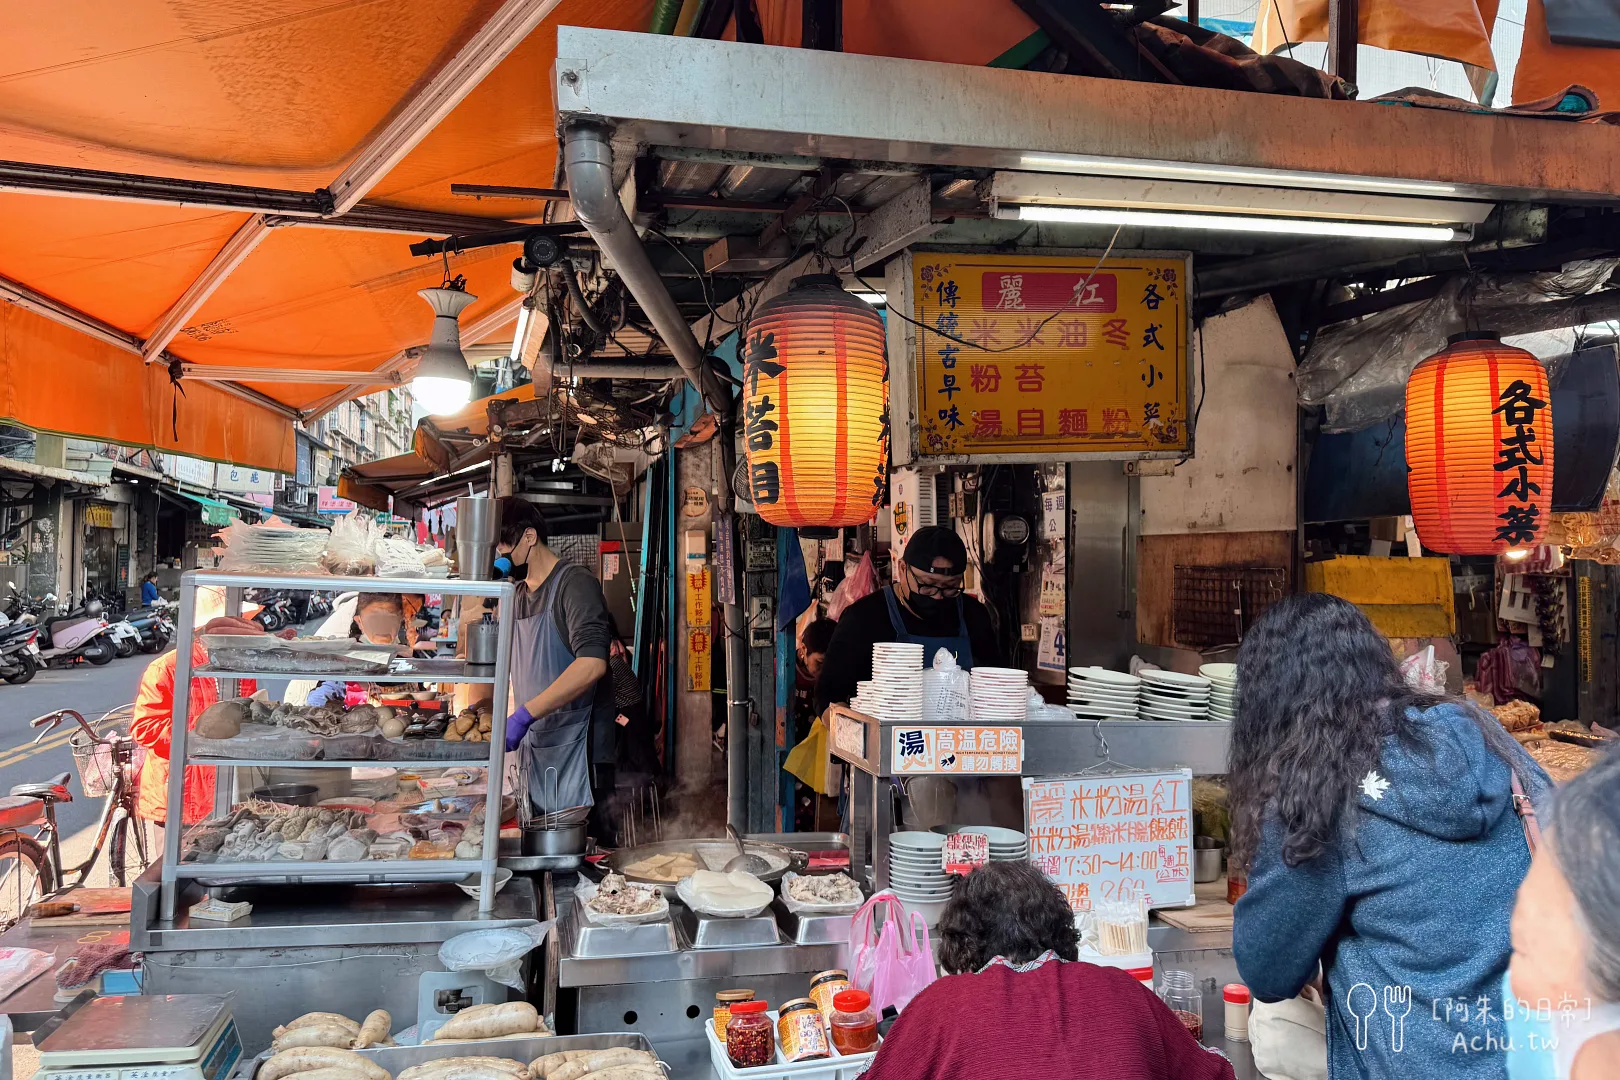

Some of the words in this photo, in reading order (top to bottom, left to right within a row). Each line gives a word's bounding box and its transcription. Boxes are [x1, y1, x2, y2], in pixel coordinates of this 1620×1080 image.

[743, 328, 788, 505] 米苔目
[1491, 380, 1548, 546] 各式小菜
